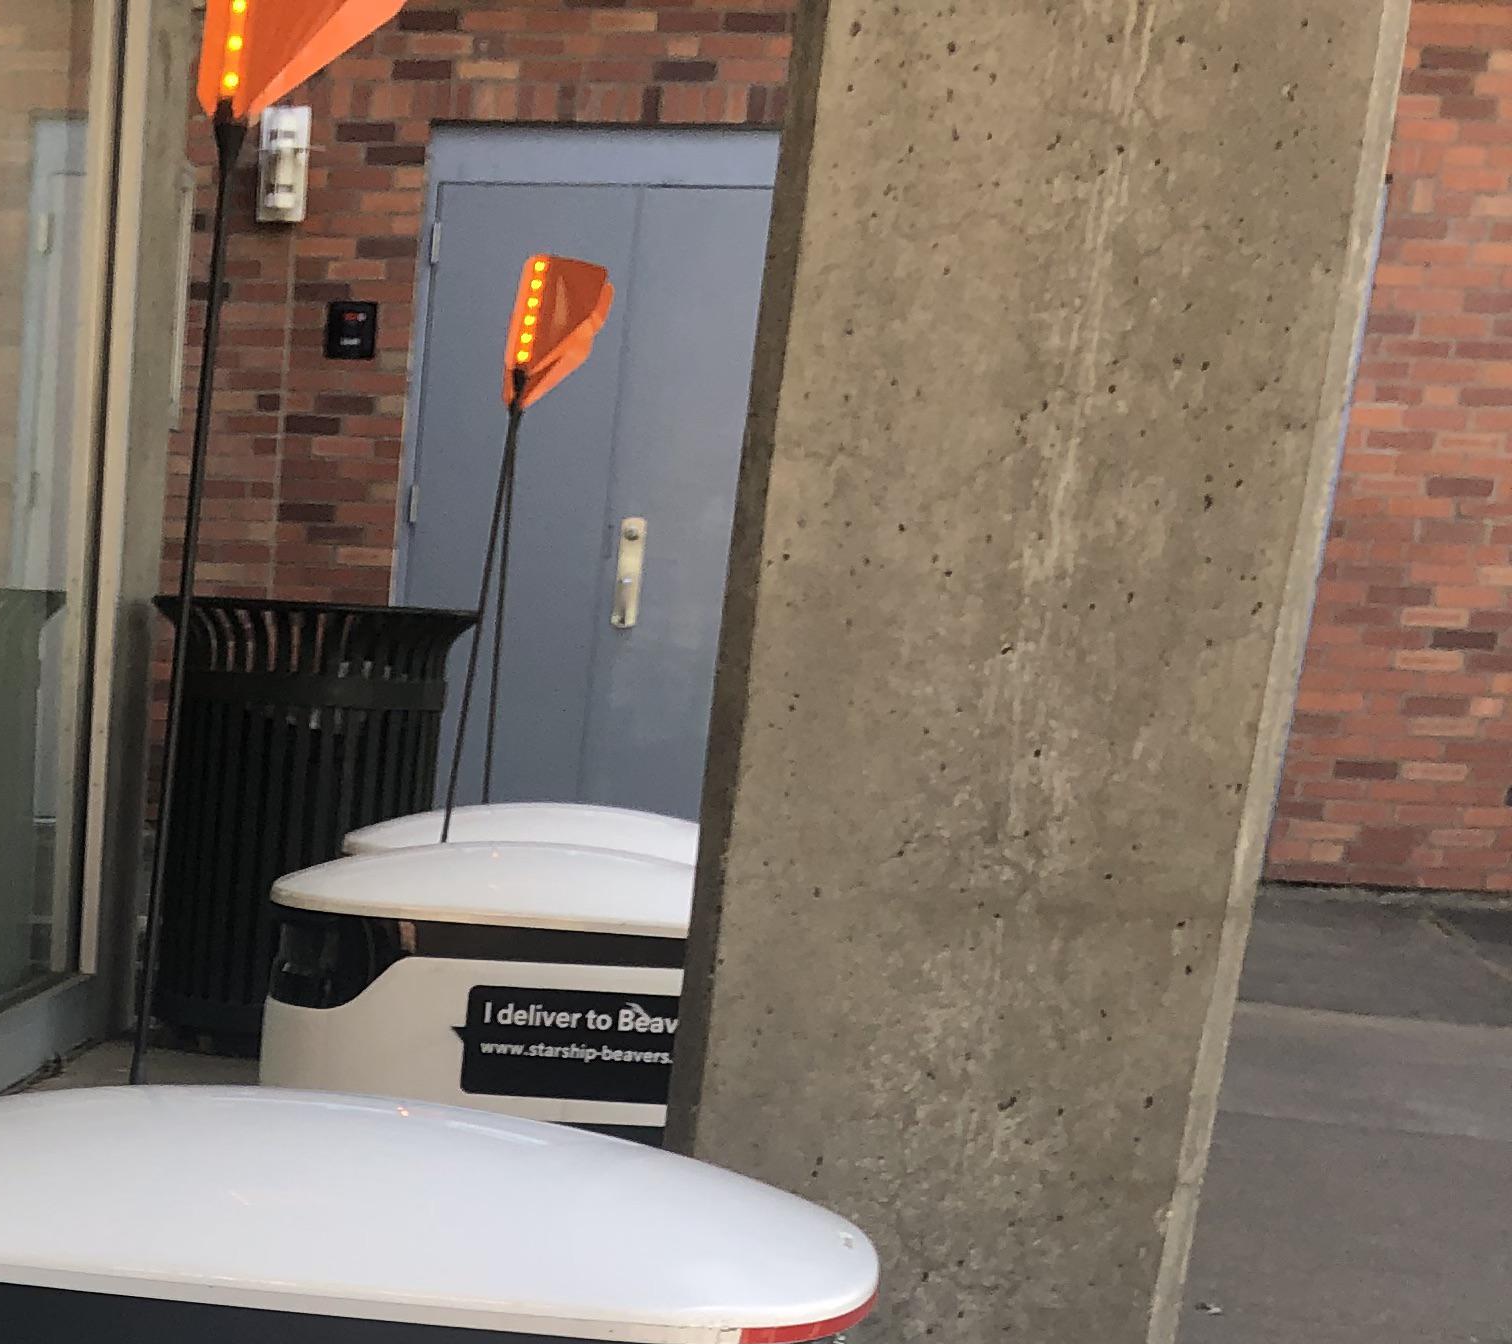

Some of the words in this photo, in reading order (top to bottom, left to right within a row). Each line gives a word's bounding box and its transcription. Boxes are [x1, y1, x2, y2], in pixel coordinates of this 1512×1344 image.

[484, 1001, 493, 1024] I
[496, 1003, 582, 1029] deliver
[585, 1010, 613, 1031] to
[617, 1008, 679, 1034] Beav
[480, 1042, 674, 1064] www.starship-beavers.
